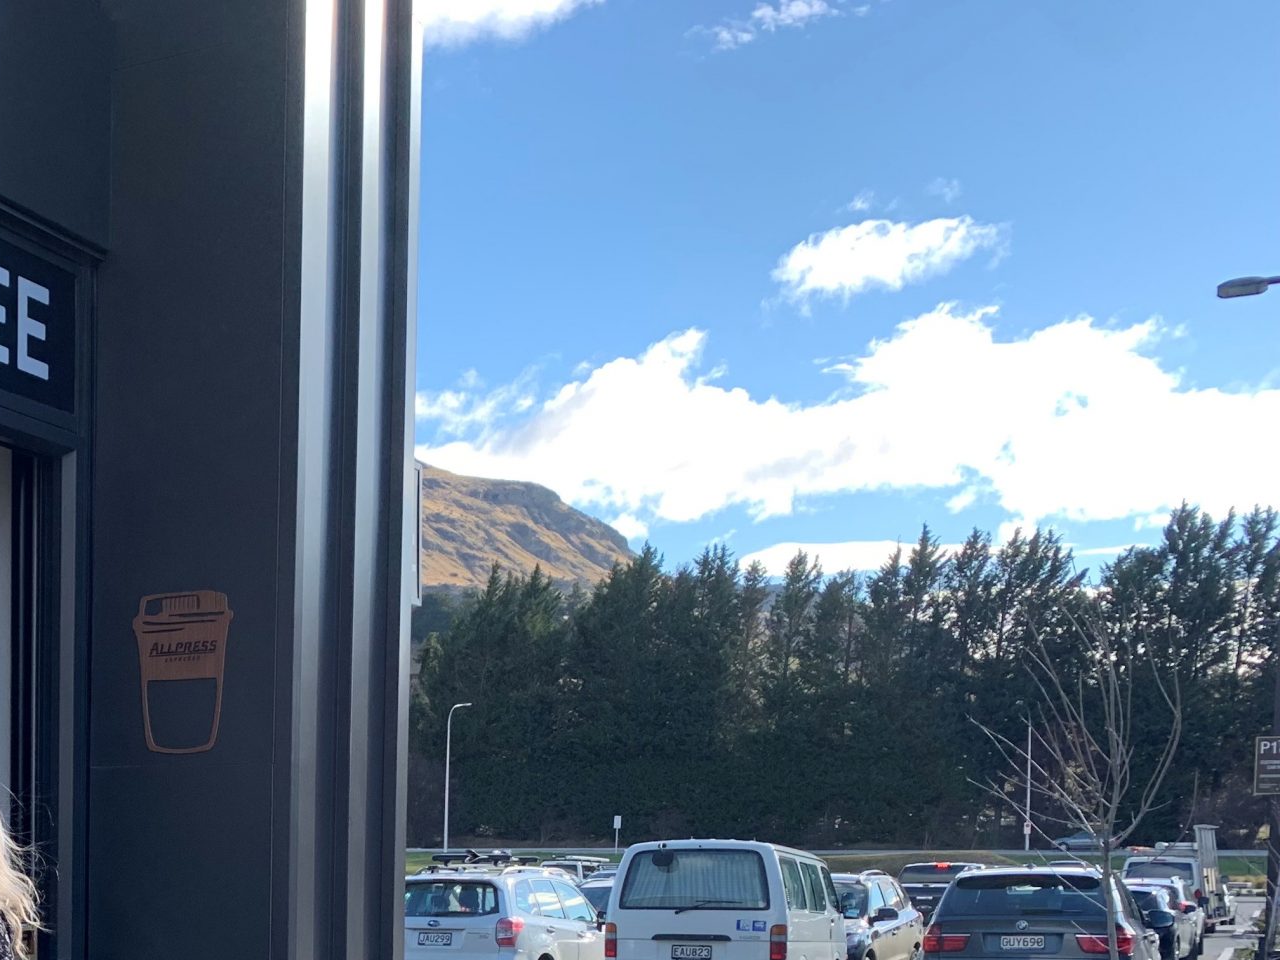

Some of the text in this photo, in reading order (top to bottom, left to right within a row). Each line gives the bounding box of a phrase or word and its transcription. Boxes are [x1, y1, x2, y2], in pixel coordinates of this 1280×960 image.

[148, 640, 218, 657] ALLPRESS
[1260, 741, 1280, 754] P1
[420, 934, 450, 943] JAU299
[1001, 937, 1044, 947] GUY690
[673, 947, 711, 958] EAU823
